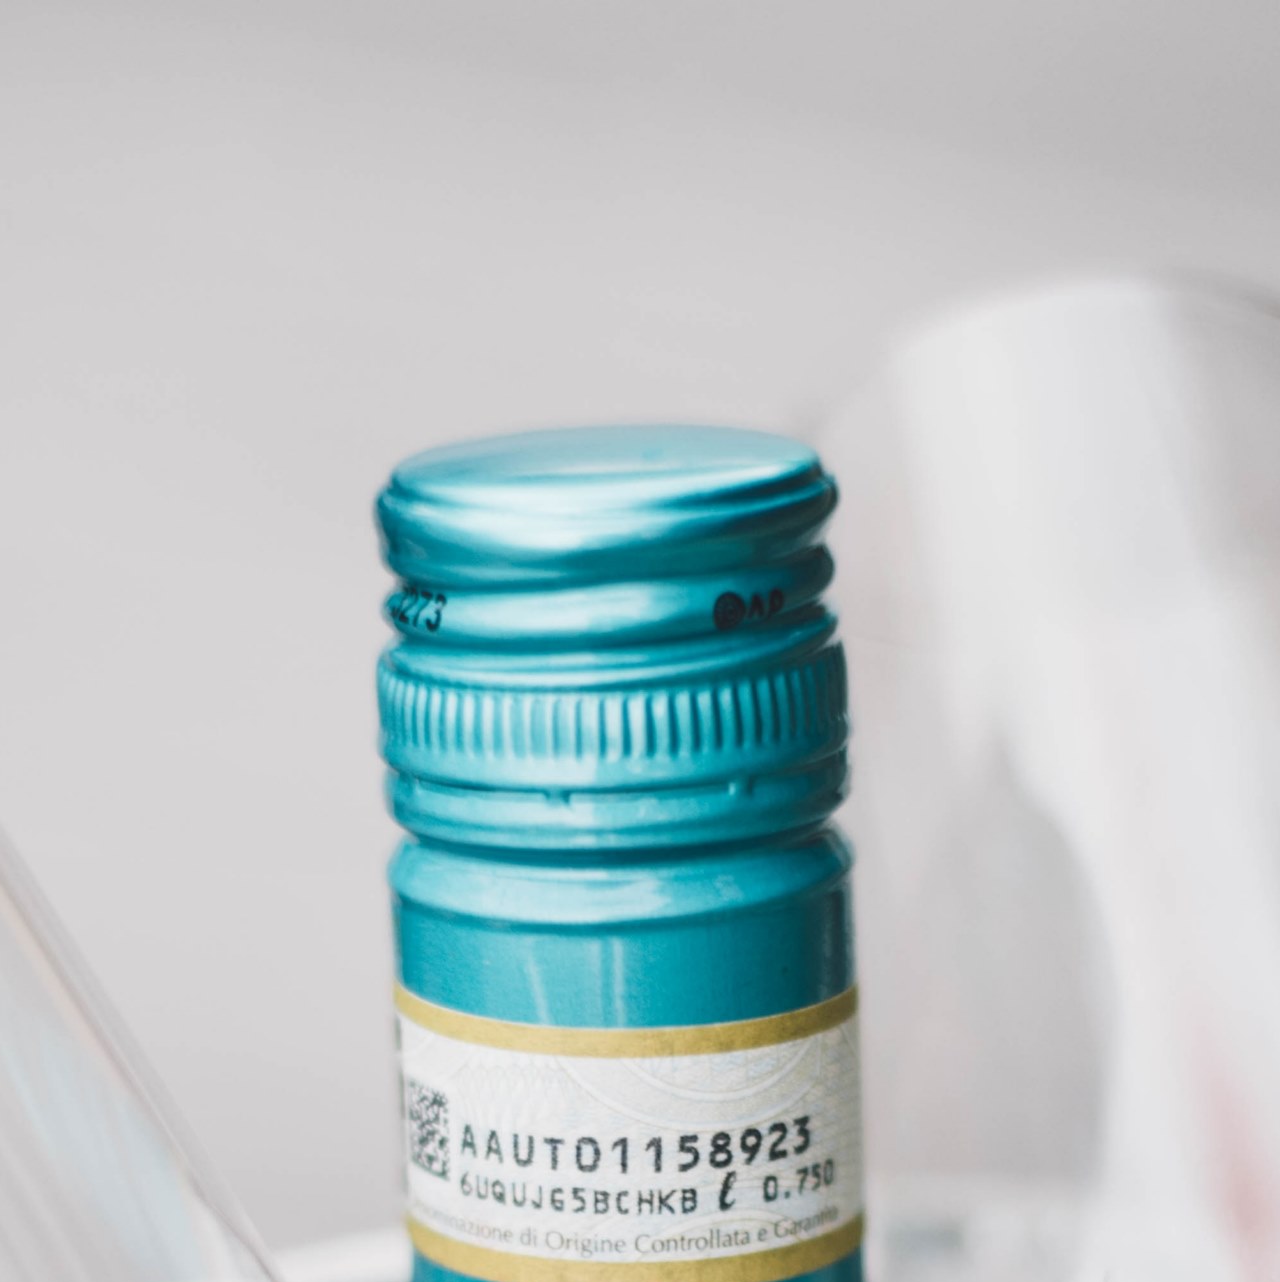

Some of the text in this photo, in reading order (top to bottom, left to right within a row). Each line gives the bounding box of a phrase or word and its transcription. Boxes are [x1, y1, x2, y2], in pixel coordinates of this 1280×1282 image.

[762, 1157, 835, 1203] 0.750
[519, 1226, 538, 1248] di
[545, 1230, 627, 1258] Origine
[634, 1228, 751, 1254] Controllata
[757, 1227, 768, 1243] e
